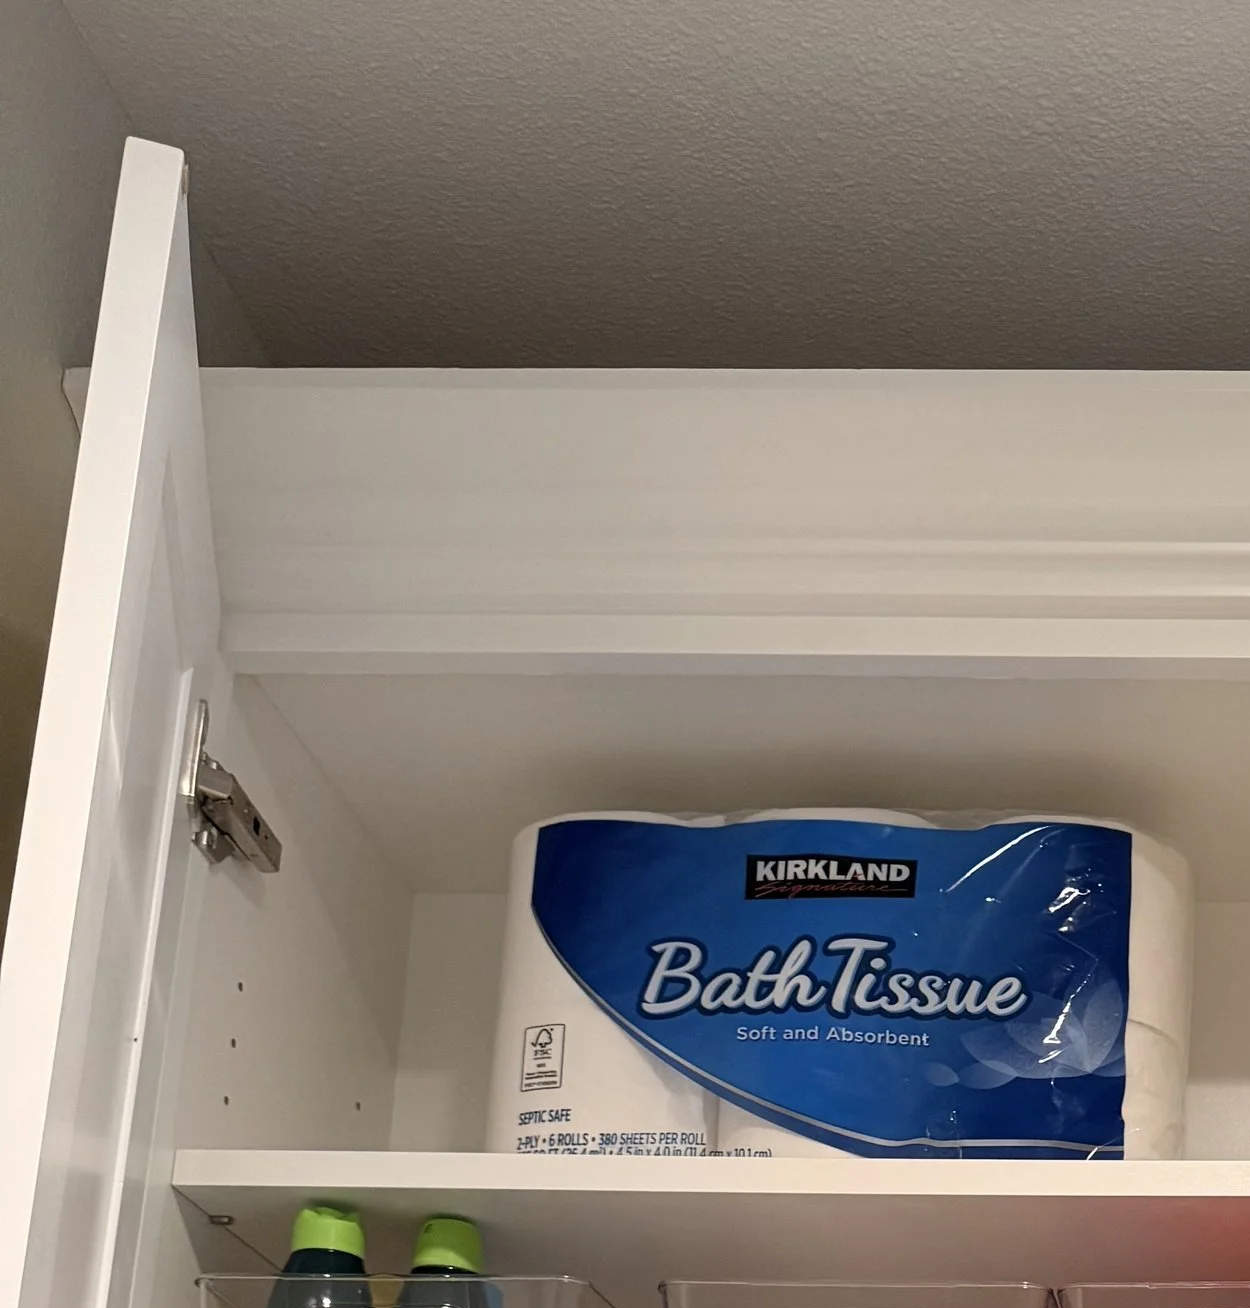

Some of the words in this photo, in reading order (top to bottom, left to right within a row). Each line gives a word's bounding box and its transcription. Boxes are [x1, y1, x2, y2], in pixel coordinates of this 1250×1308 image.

[756, 859, 910, 882] KIRKLAND
[755, 881, 908, 899] Signature
[642, 938, 828, 1015] Bath
[827, 937, 1028, 1016] Tissue
[736, 1026, 777, 1040] Soft
[783, 1026, 819, 1040] and
[826, 1027, 930, 1046] Absorbent
[518, 1110, 547, 1126] SEPTIC
[548, 1108, 571, 1122] SAFE
[549, 1133, 556, 1147] 6
[557, 1133, 589, 1146] ROLLS
[598, 1132, 618, 1146] 380
[619, 1132, 657, 1145] SHEETS
[659, 1132, 679, 1145] PER
[680, 1132, 707, 1146] ROLL
